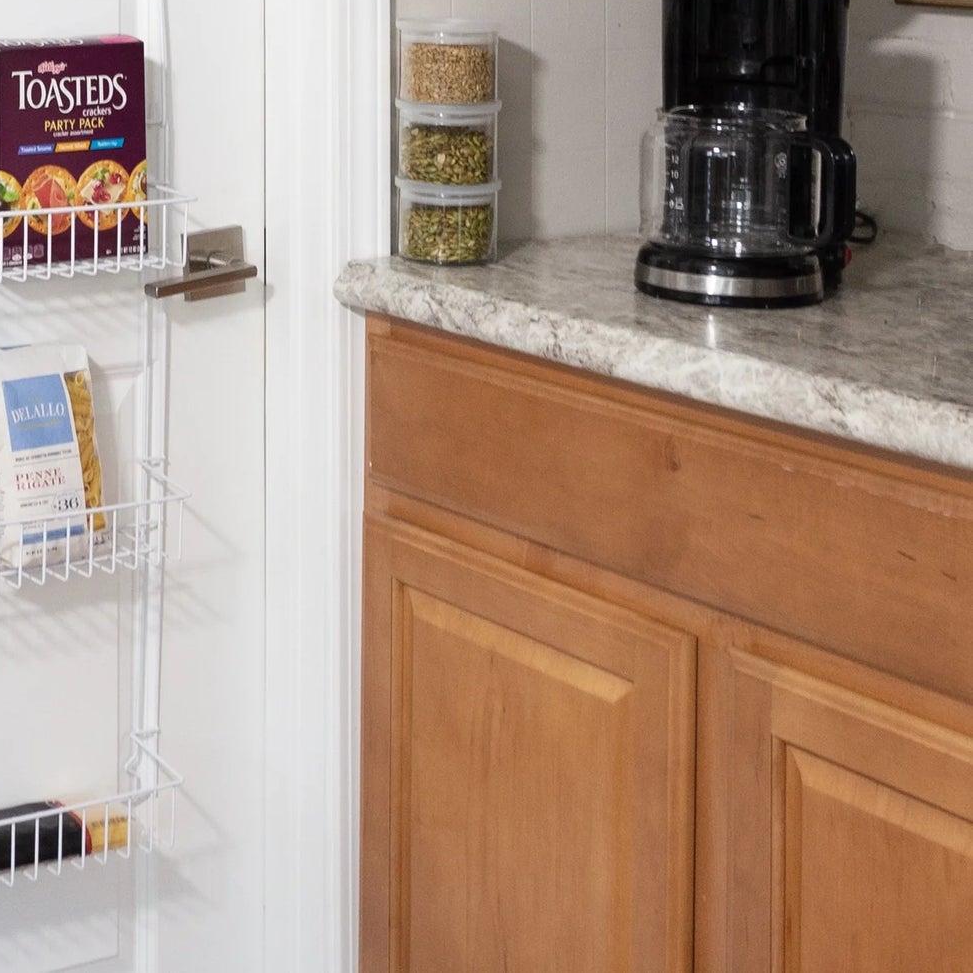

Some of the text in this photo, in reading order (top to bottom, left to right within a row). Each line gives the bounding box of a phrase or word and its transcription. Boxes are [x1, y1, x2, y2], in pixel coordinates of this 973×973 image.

[11, 70, 127, 114] TOASTEDS
[82, 106, 112, 117] crackers
[44, 116, 105, 132] PARTY PACK
[10, 402, 65, 424] DELALLO
[15, 467, 63, 482] PENNE
[16, 475, 66, 491] RIGATE
